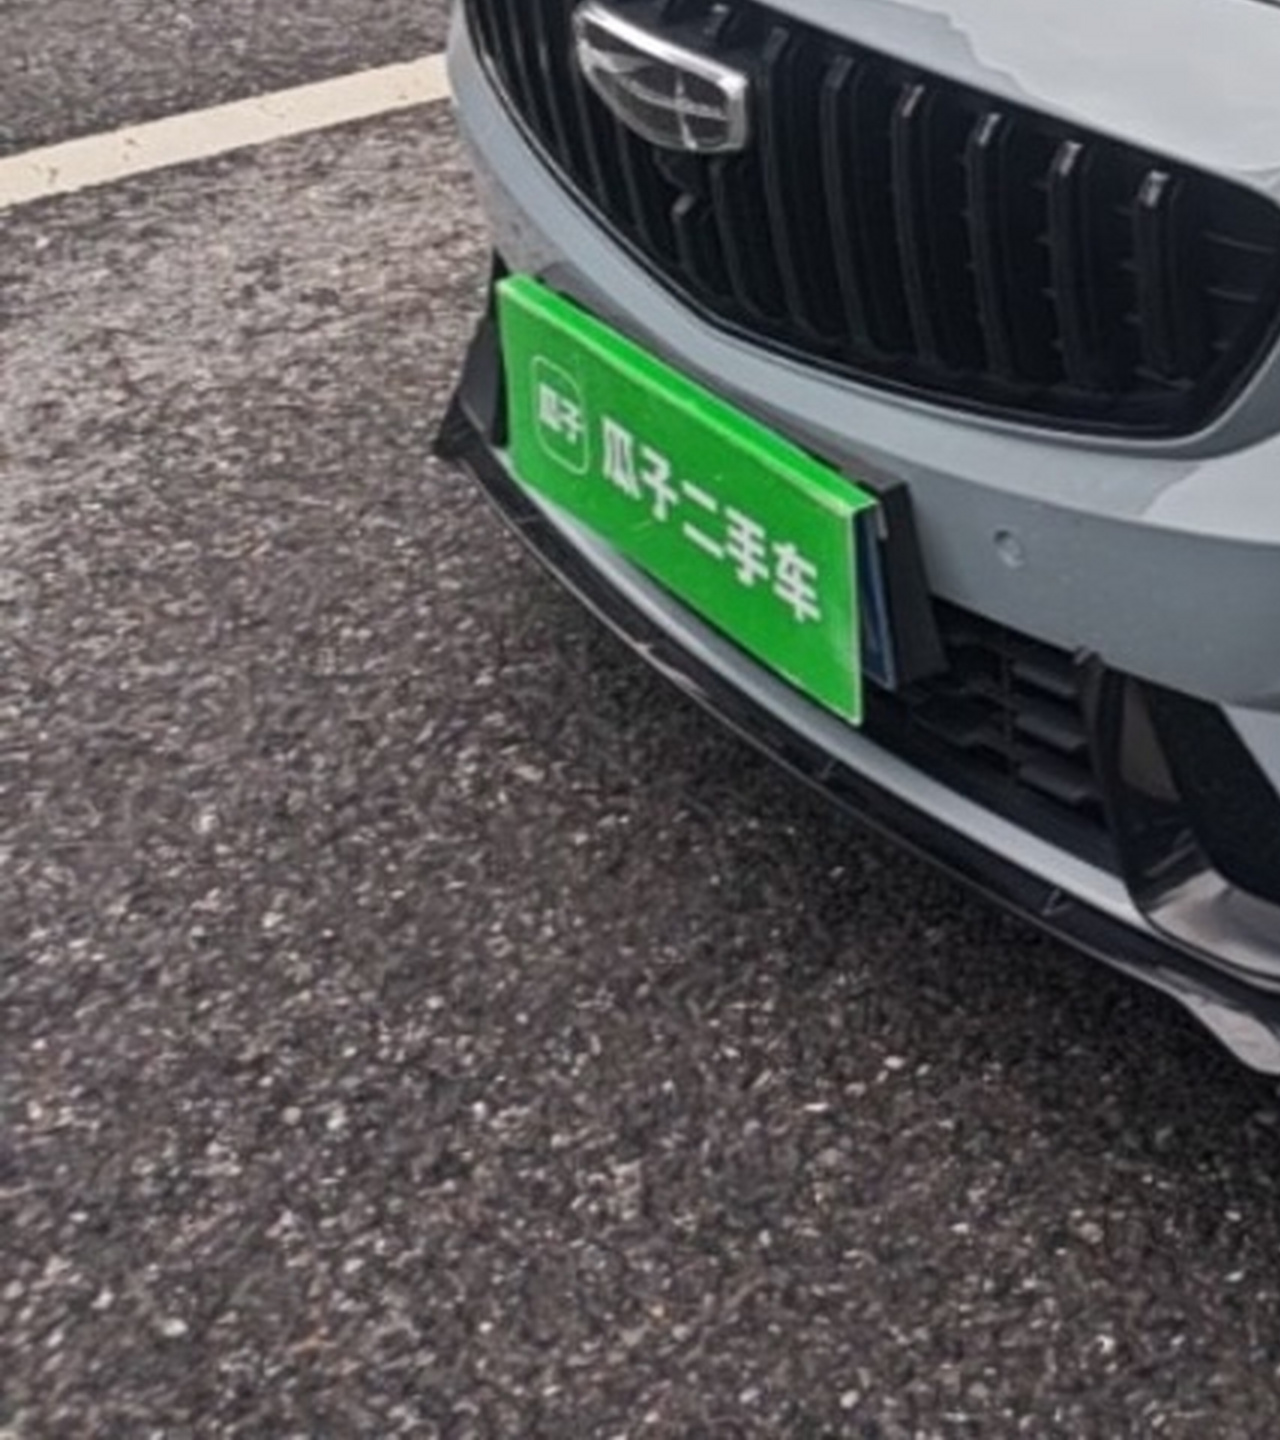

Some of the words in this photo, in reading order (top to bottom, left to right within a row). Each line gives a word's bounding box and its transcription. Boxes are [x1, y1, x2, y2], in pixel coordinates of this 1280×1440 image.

[602, 416, 820, 622] 瓜子二手车
